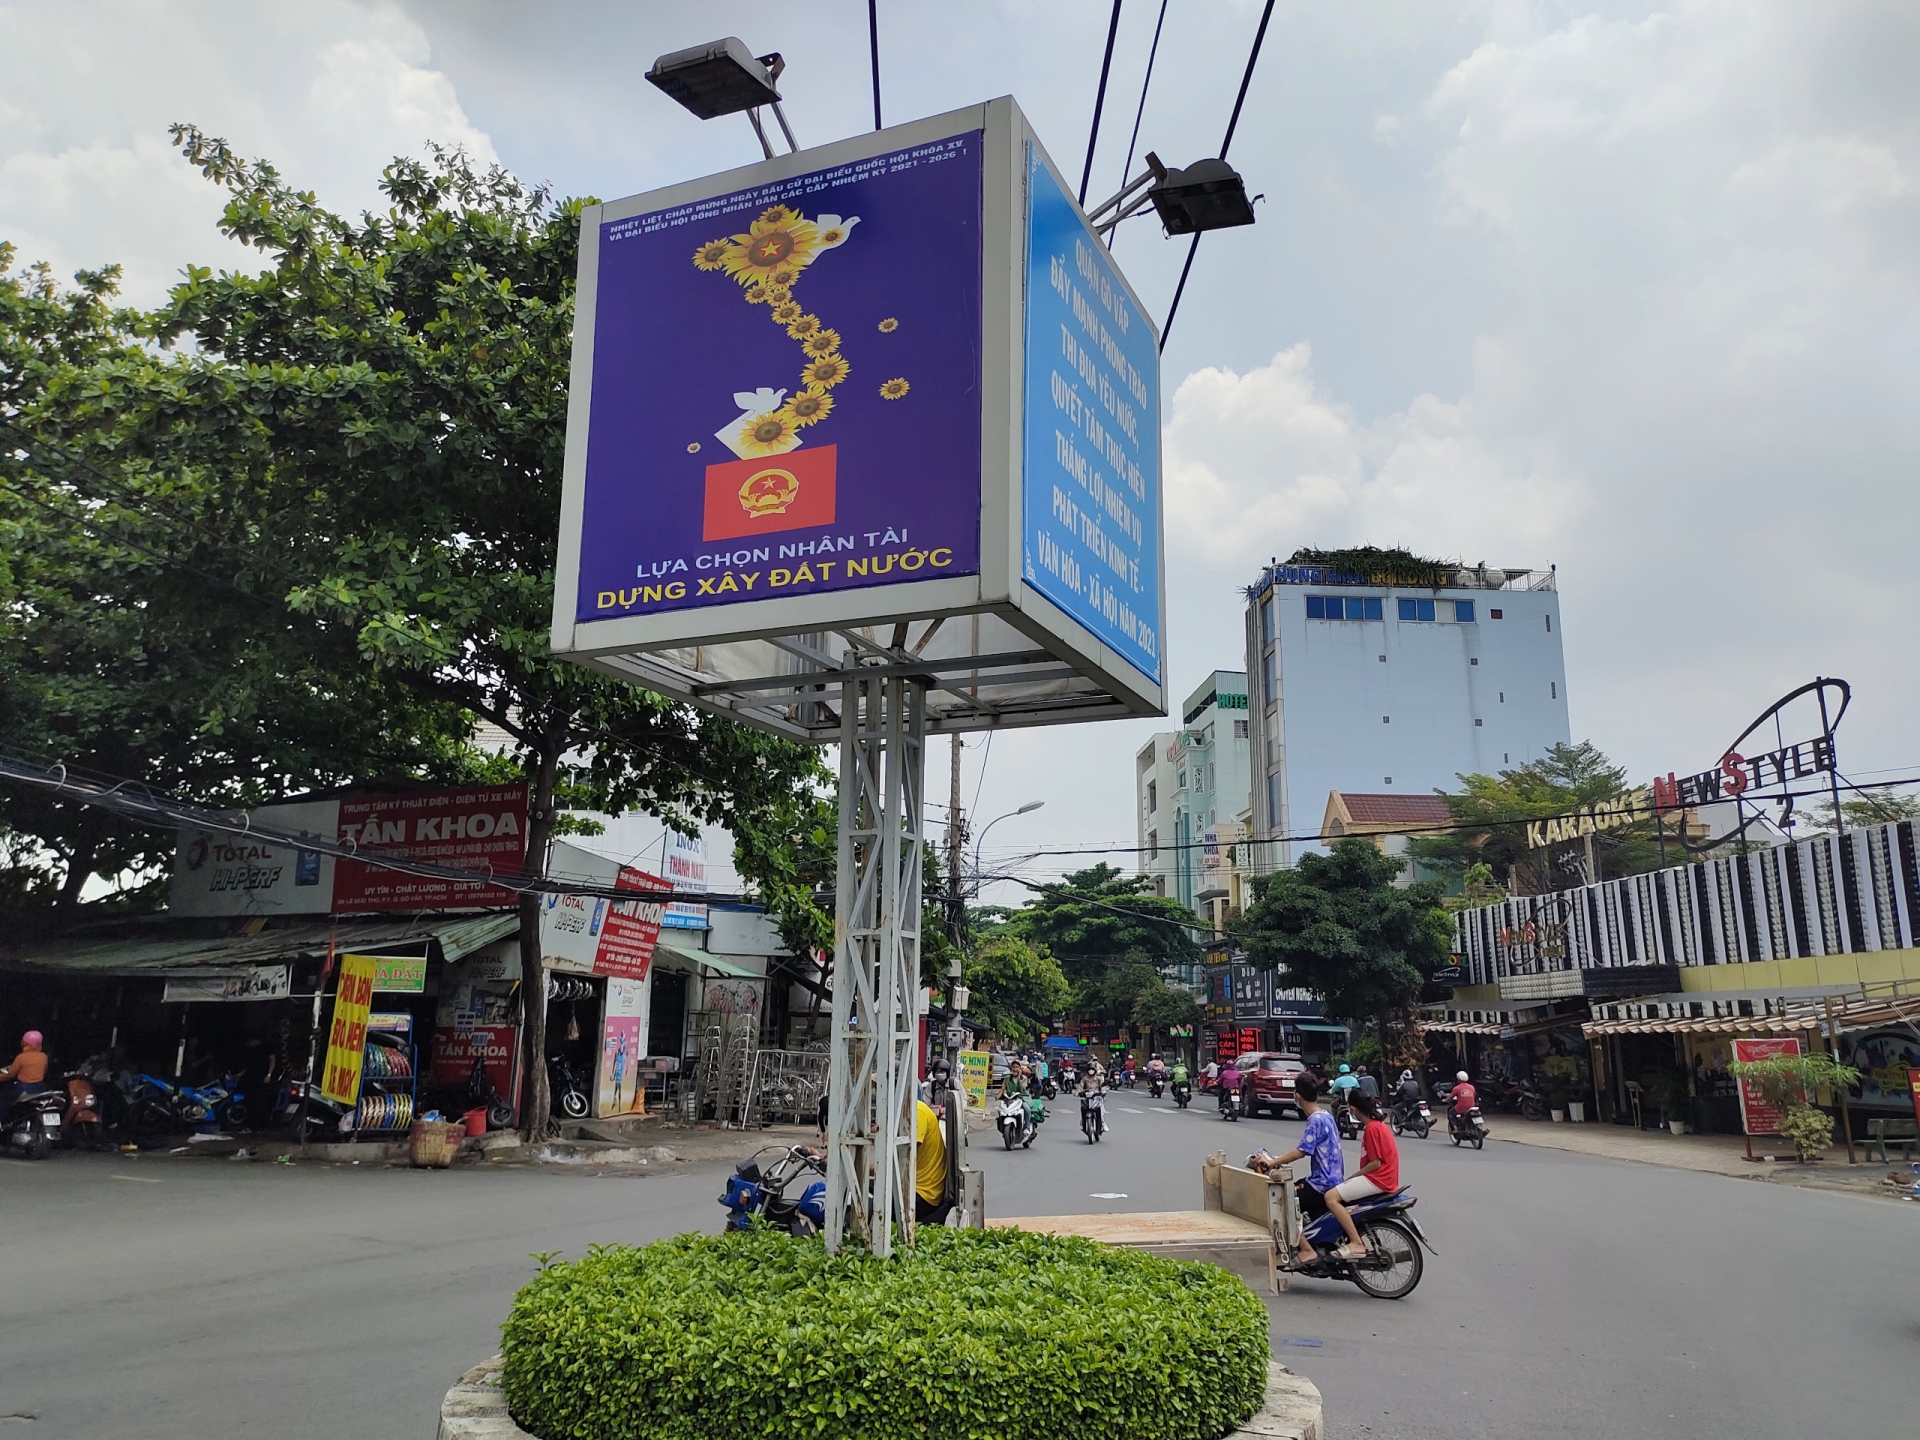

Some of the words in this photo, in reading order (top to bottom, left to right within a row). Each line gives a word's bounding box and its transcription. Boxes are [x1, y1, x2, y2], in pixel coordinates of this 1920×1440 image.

[609, 231, 623, 242] VÀ
[624, 226, 642, 239] ĐẠI
[644, 219, 669, 234] BIỂU
[670, 216, 689, 228] HỘI
[691, 208, 720, 222] ĐỒNG
[722, 200, 753, 215] NHÂN
[755, 193, 779, 206] DÂN
[780, 186, 803, 200] CÁC
[806, 180, 829, 194] CẤP
[831, 172, 869, 188] NHIỆM
[872, 165, 887, 178] KỲ
[890, 159, 919, 174] 2021
[928, 151, 957, 164] 2026
[610, 219, 640, 234] NHIỆT
[642, 214, 662, 228] LIỆT
[665, 207, 693, 220] CHÀO
[696, 199, 728, 213] MỪNG
[730, 190, 759, 205] NGÀY
[761, 183, 784, 196] BẦU
[786, 177, 803, 189] CỬ
[804, 174, 824, 186] ĐẠI
[826, 166, 852, 180] BIỂU
[855, 157, 886, 173] QUỐC
[889, 152, 909, 166] HỘI
[913, 144, 944, 158] KHÓA
[947, 139, 965, 149] XV
[1075, 238, 1100, 295] QUẬN
[1101, 274, 1113, 313] GÒ
[1113, 295, 1130, 337] VẤP
[1050, 253, 1071, 306] ĐẨY
[1072, 285, 1099, 346] MẠNH
[1100, 323, 1127, 382] PHONG
[1128, 363, 1147, 411] TRÀO
[1061, 322, 1078, 370] THI
[1079, 347, 1097, 395] ĐUA
[1099, 371, 1116, 417] YÊU
[1051, 369, 1083, 429] QUYẾT
[1084, 402, 1104, 456] TÂM
[1105, 431, 1127, 482] THỰC
[1127, 456, 1146, 504] HIỆN
[1055, 428, 1088, 490] THẮNG
[1088, 464, 1104, 509] LỢI
[1104, 482, 1133, 537] NHIỆM
[1132, 512, 1143, 552] VỤ
[636, 559, 690, 579] LỰA
[694, 547, 770, 571] CHỌN
[778, 534, 856, 558] NHÂN
[863, 525, 909, 549] TÀI
[1053, 483, 1079, 536] PHÁT
[1080, 511, 1107, 561] TRIỂN
[1108, 538, 1128, 586] KINH
[1128, 556, 1140, 594] TẾ
[596, 580, 687, 611] DỰNG
[695, 567, 762, 597] XÂY
[768, 558, 837, 587] ĐẤT
[846, 546, 954, 578] NƯỚC
[1037, 529, 1060, 579] VĂN
[1061, 549, 1082, 597] HÓA
[1088, 572, 1102, 613] XÃ
[1102, 585, 1118, 629] HỘI
[1119, 603, 1137, 642] NĂM
[1138, 619, 1156, 660] 2021
[343, 803, 370, 814] TRUNG
[371, 800, 388, 811] TÂM
[401, 797, 429, 809] THUẬT
[428, 796, 449, 808] ĐIỆN
[455, 793, 476, 806] ĐIỆN
[490, 792, 502, 802] XE
[503, 789, 522, 801] MÁY
[1526, 789, 1652, 850] KARAOKE
[1776, 794, 1797, 828] 2
[415, 812, 520, 843] KHOA
[676, 833, 700, 854] INOX
[213, 845, 272, 862] TOTAL
[209, 866, 284, 892] HI-PERF
[364, 887, 376, 895] UY
[377, 884, 389, 894] TÍN
[395, 883, 417, 893] CHẤT
[418, 883, 447, 894] LƯỢNG
[635, 900, 667, 927] KHOA
[392, 965, 421, 979] ĐẤT
[472, 955, 502, 964] TOTAL
[467, 1045, 508, 1057] KHOA
[968, 1056, 987, 1067] MINH
